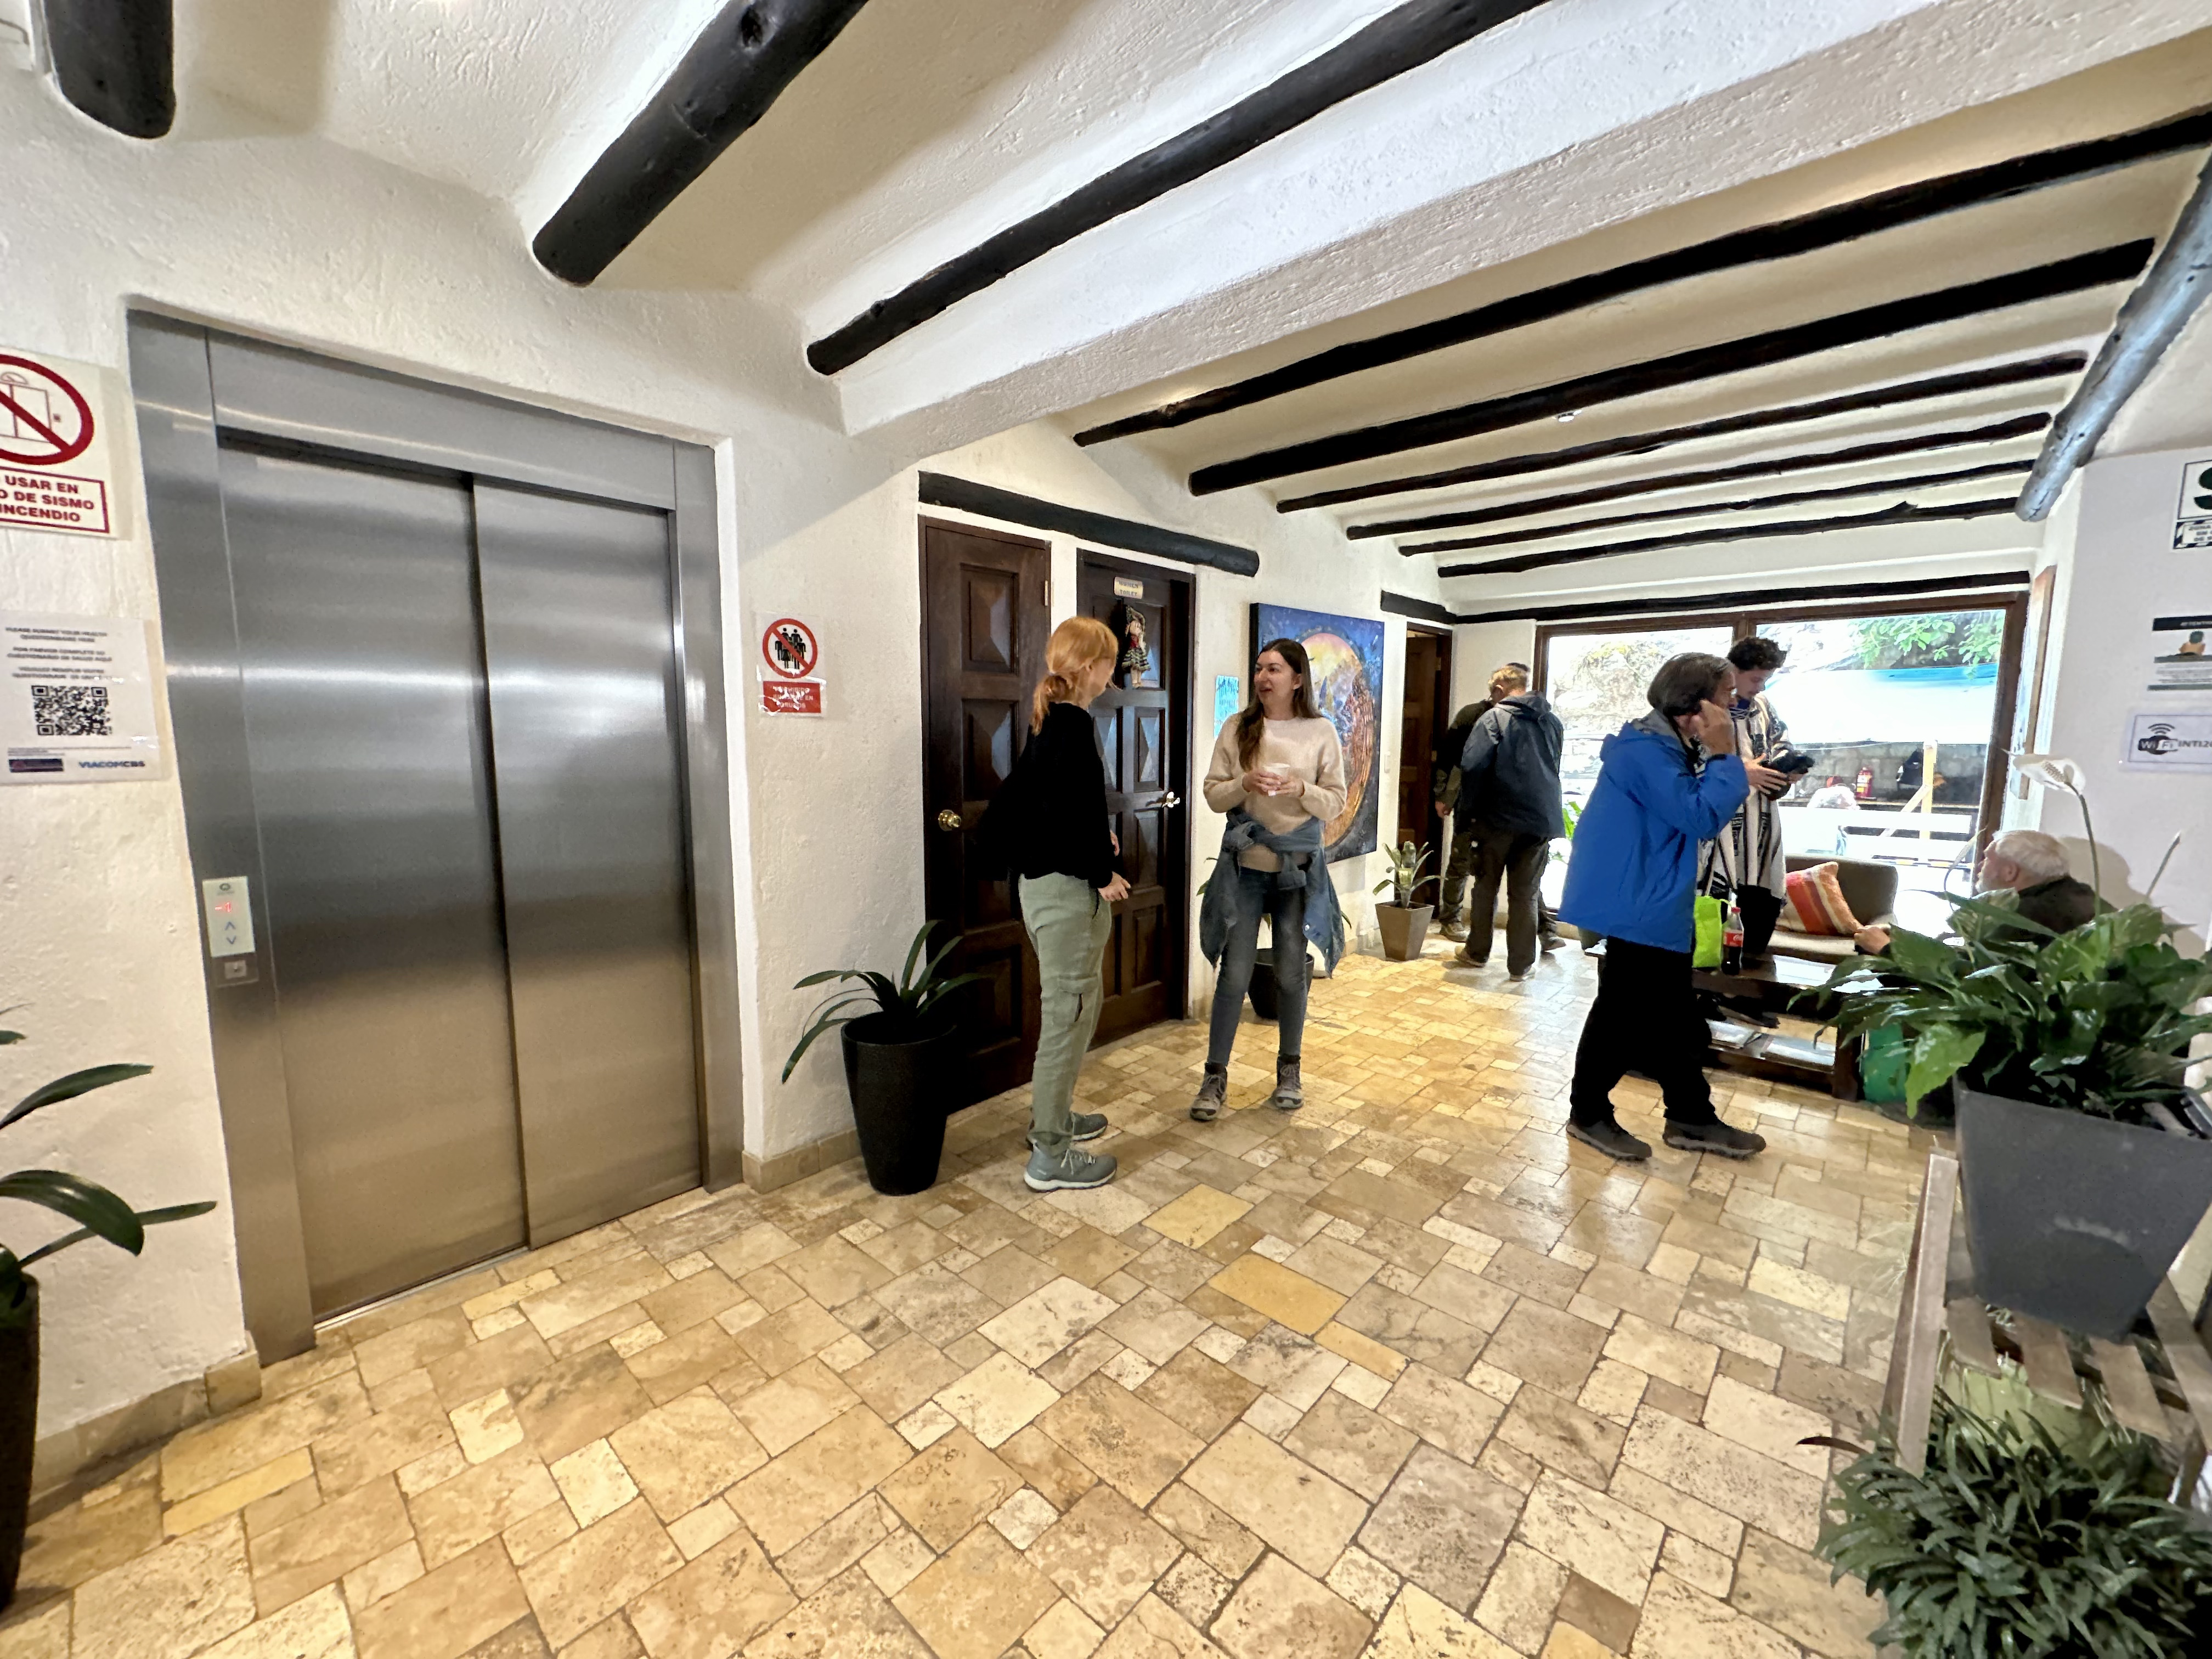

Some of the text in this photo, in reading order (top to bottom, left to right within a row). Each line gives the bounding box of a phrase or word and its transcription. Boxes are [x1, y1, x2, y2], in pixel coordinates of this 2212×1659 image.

[5, 475, 78, 493] USAR EN
[14, 492, 37, 503] DE
[42, 495, 94, 510] SISMO
